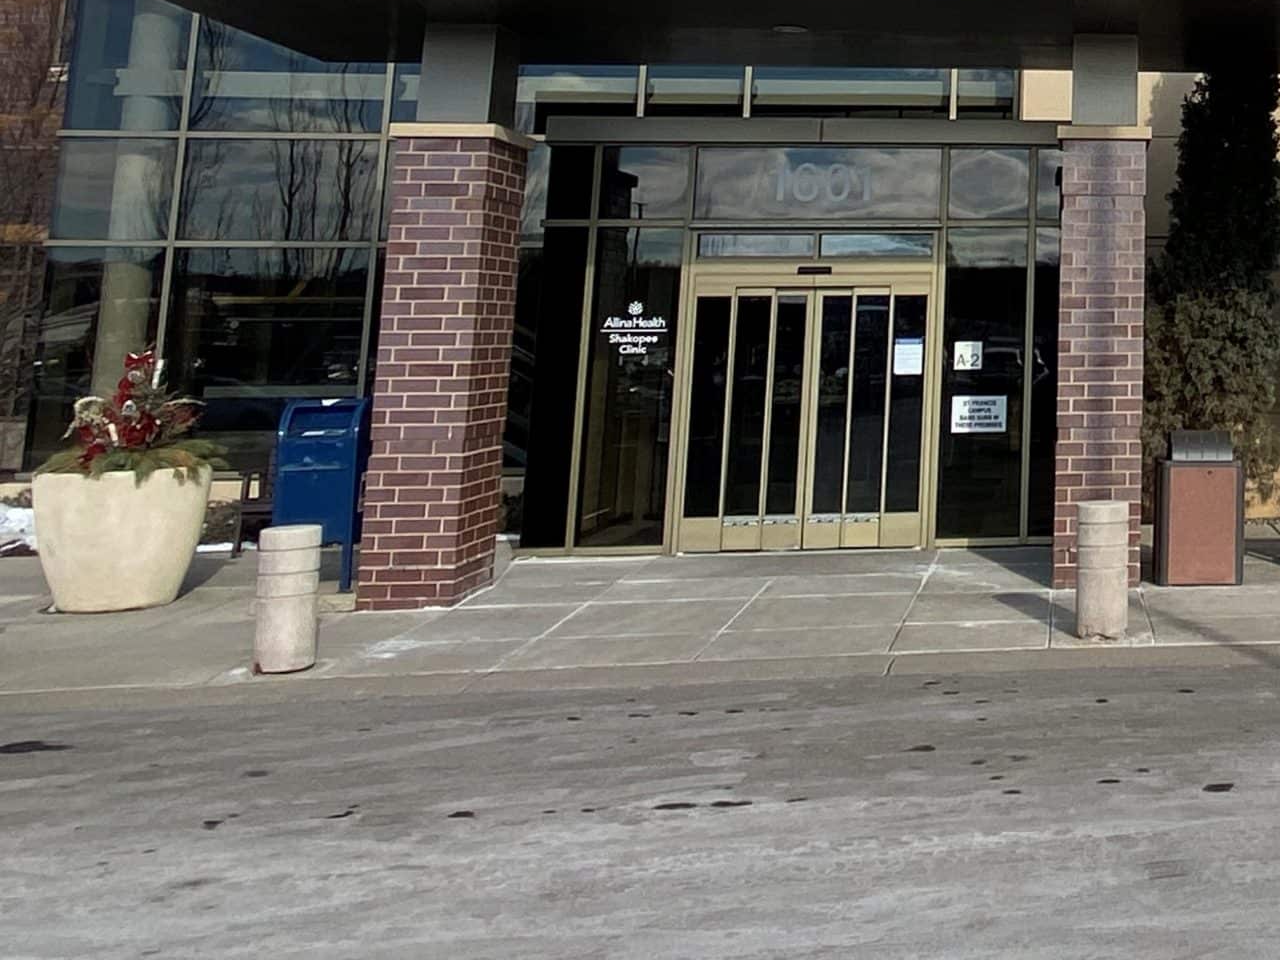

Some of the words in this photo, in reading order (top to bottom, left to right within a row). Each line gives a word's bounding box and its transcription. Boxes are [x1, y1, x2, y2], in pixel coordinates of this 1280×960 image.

[774, 162, 873, 202] 1601
[603, 316, 632, 328] Allina
[633, 316, 666, 328] Health
[609, 333, 658, 347] Shakopee
[619, 344, 647, 354] Clinic
[956, 353, 980, 367] A-2
